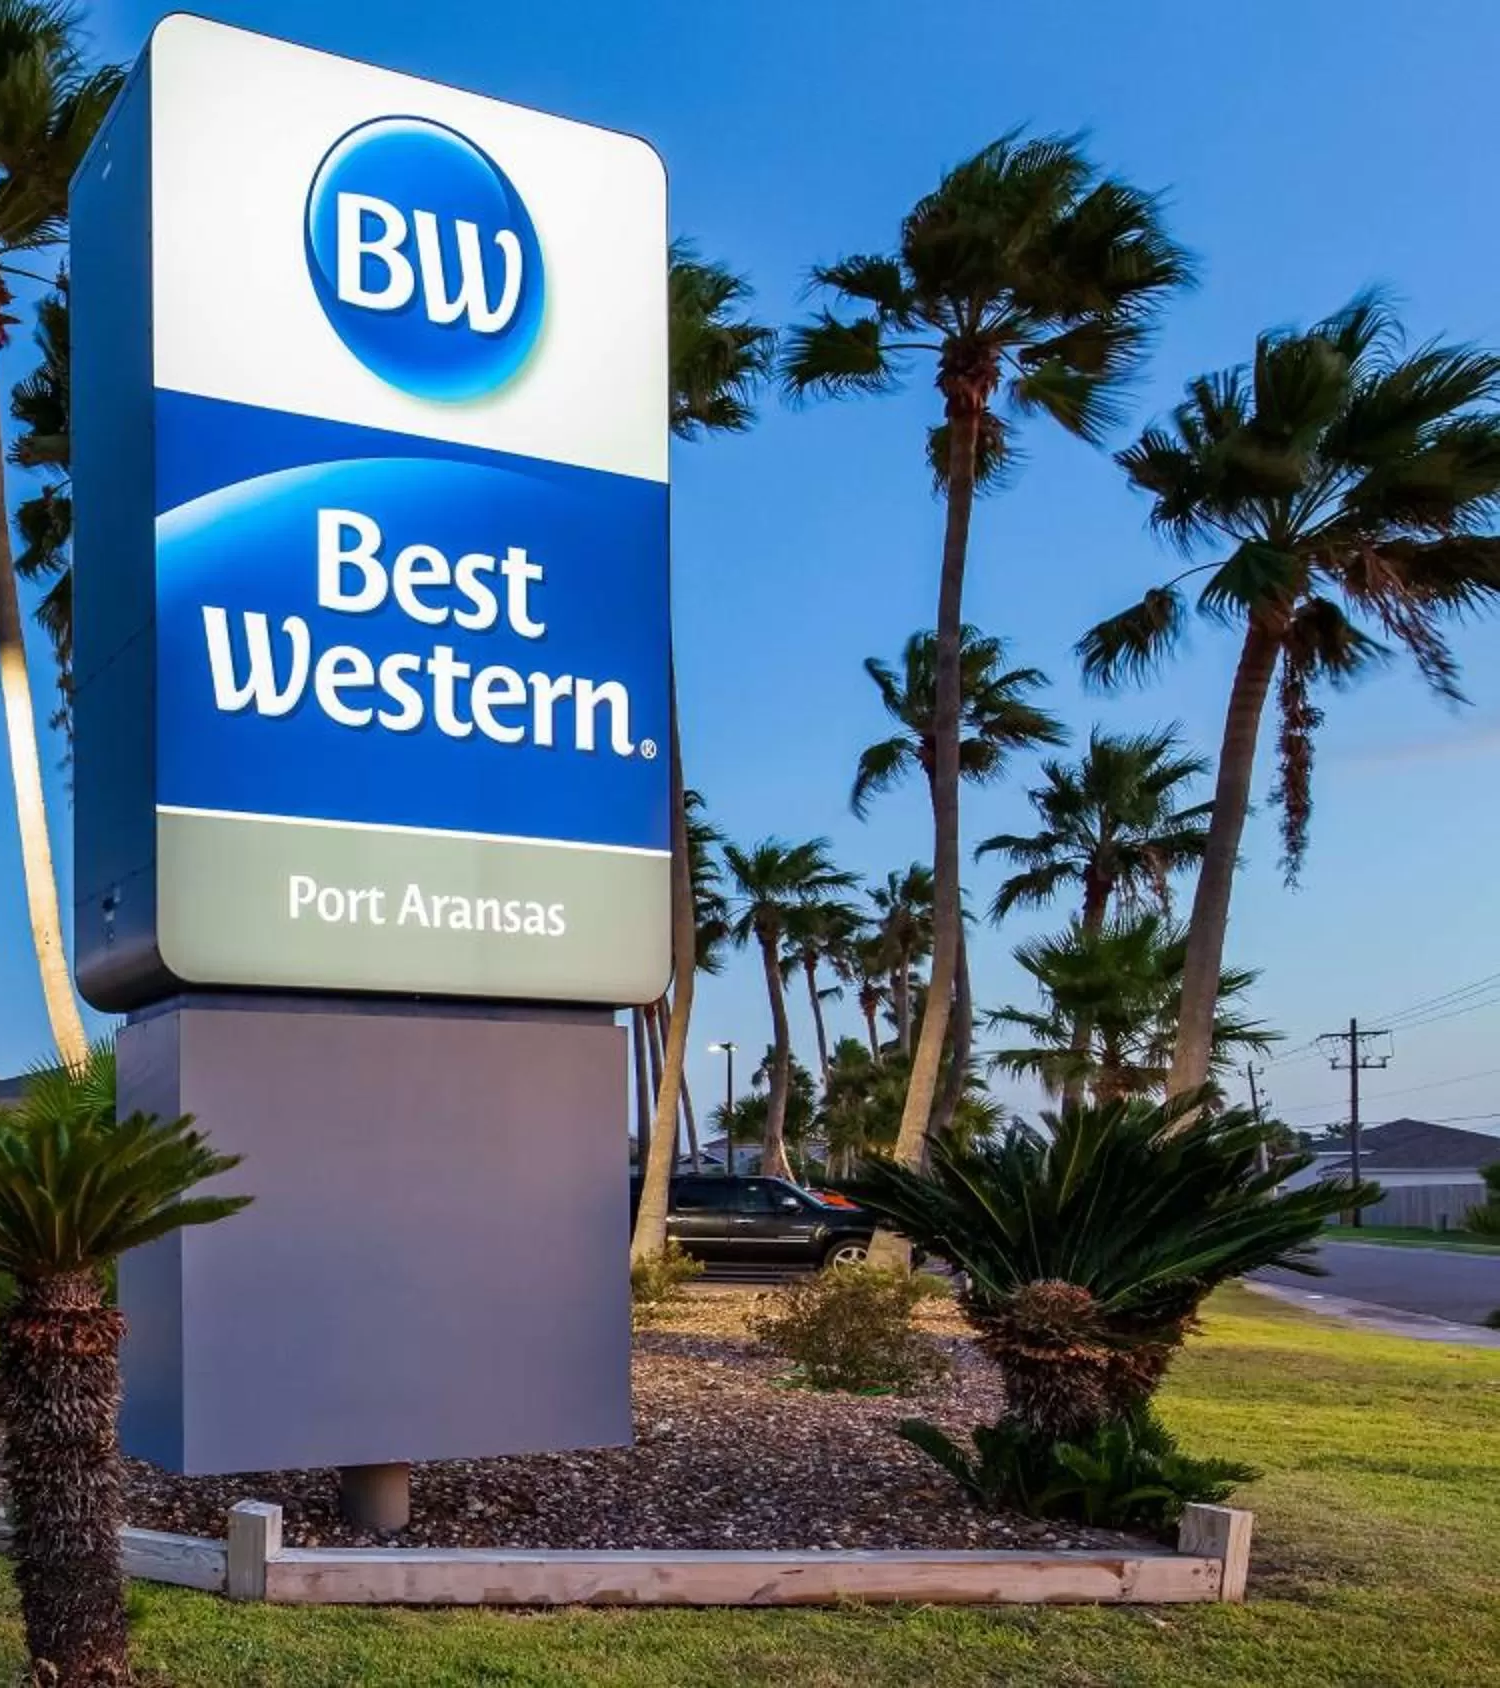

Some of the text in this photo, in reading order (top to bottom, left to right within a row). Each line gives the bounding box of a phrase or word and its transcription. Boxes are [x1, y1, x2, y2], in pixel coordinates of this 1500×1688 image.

[337, 190, 523, 333] BW
[316, 508, 546, 639] Best
[288, 874, 567, 937] Port Aransas
